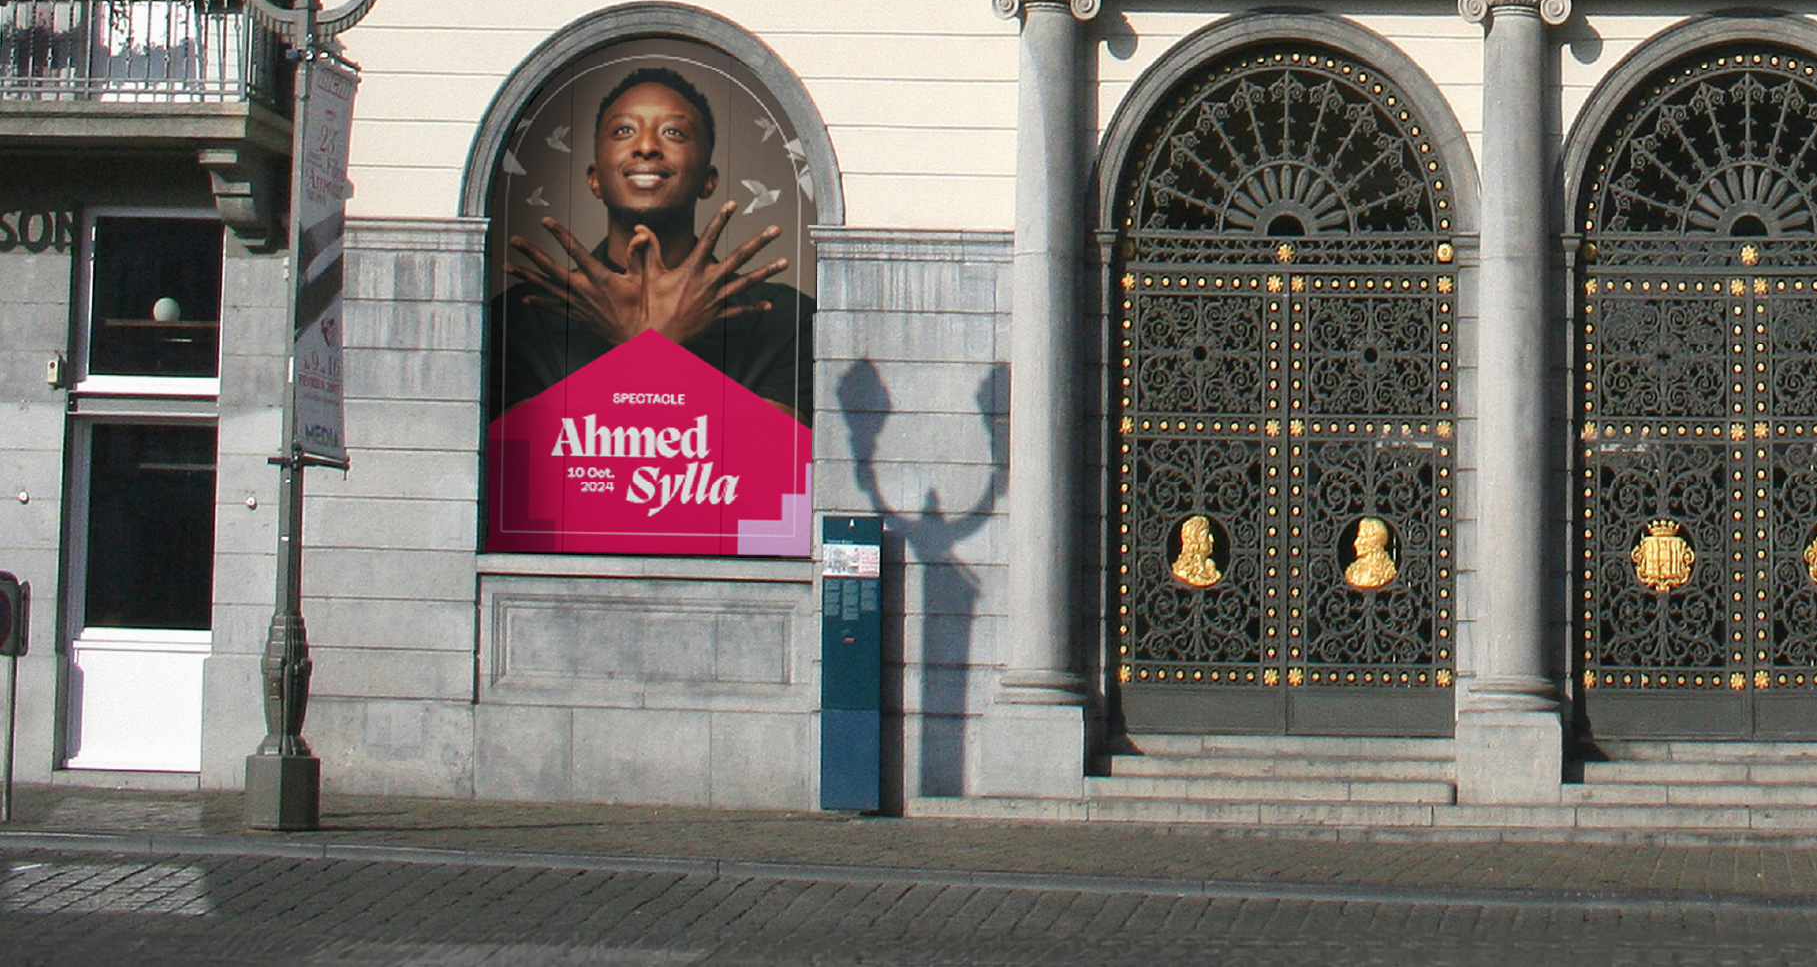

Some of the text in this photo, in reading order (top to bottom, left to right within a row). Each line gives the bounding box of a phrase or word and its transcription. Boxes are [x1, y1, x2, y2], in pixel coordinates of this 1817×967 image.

[613, 392, 686, 405] SPECTACLE
[551, 413, 711, 459] Ahmed
[567, 467, 615, 479] 10 Oct.
[580, 481, 615, 493] 2024
[626, 462, 740, 517] Sylla
